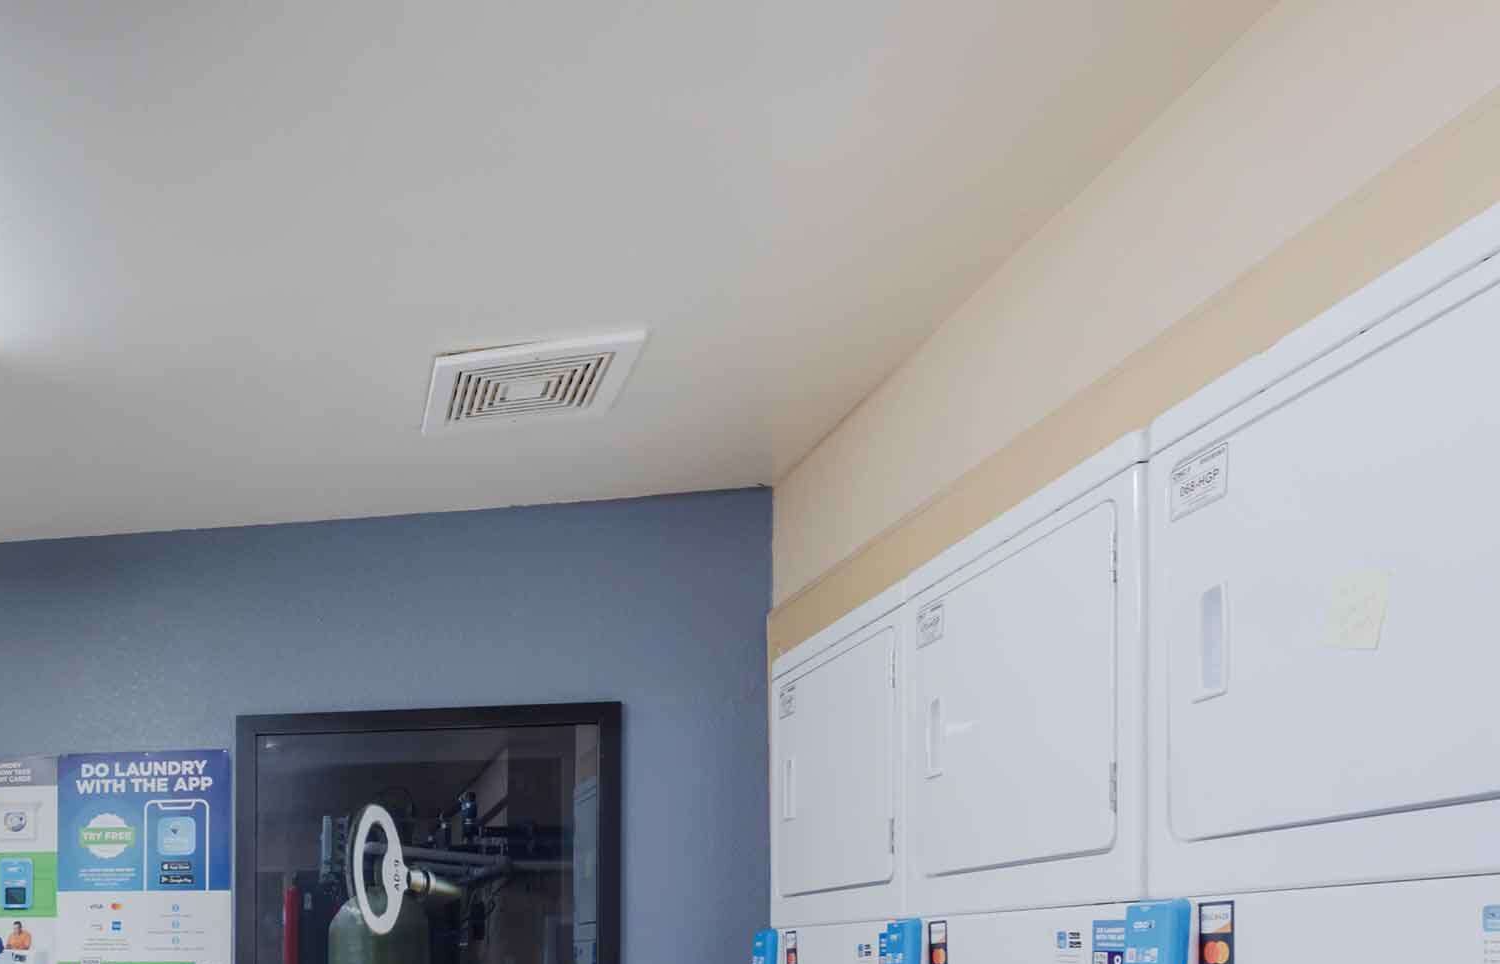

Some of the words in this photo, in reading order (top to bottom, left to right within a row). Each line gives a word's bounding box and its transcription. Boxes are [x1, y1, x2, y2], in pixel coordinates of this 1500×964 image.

[81, 763, 109, 778] DO
[114, 759, 208, 777] LAUNDRY
[76, 779, 126, 795] WITH
[130, 777, 169, 793] THE
[173, 776, 213, 792] APP
[84, 831, 102, 841] TRY
[104, 830, 133, 840] FREE
